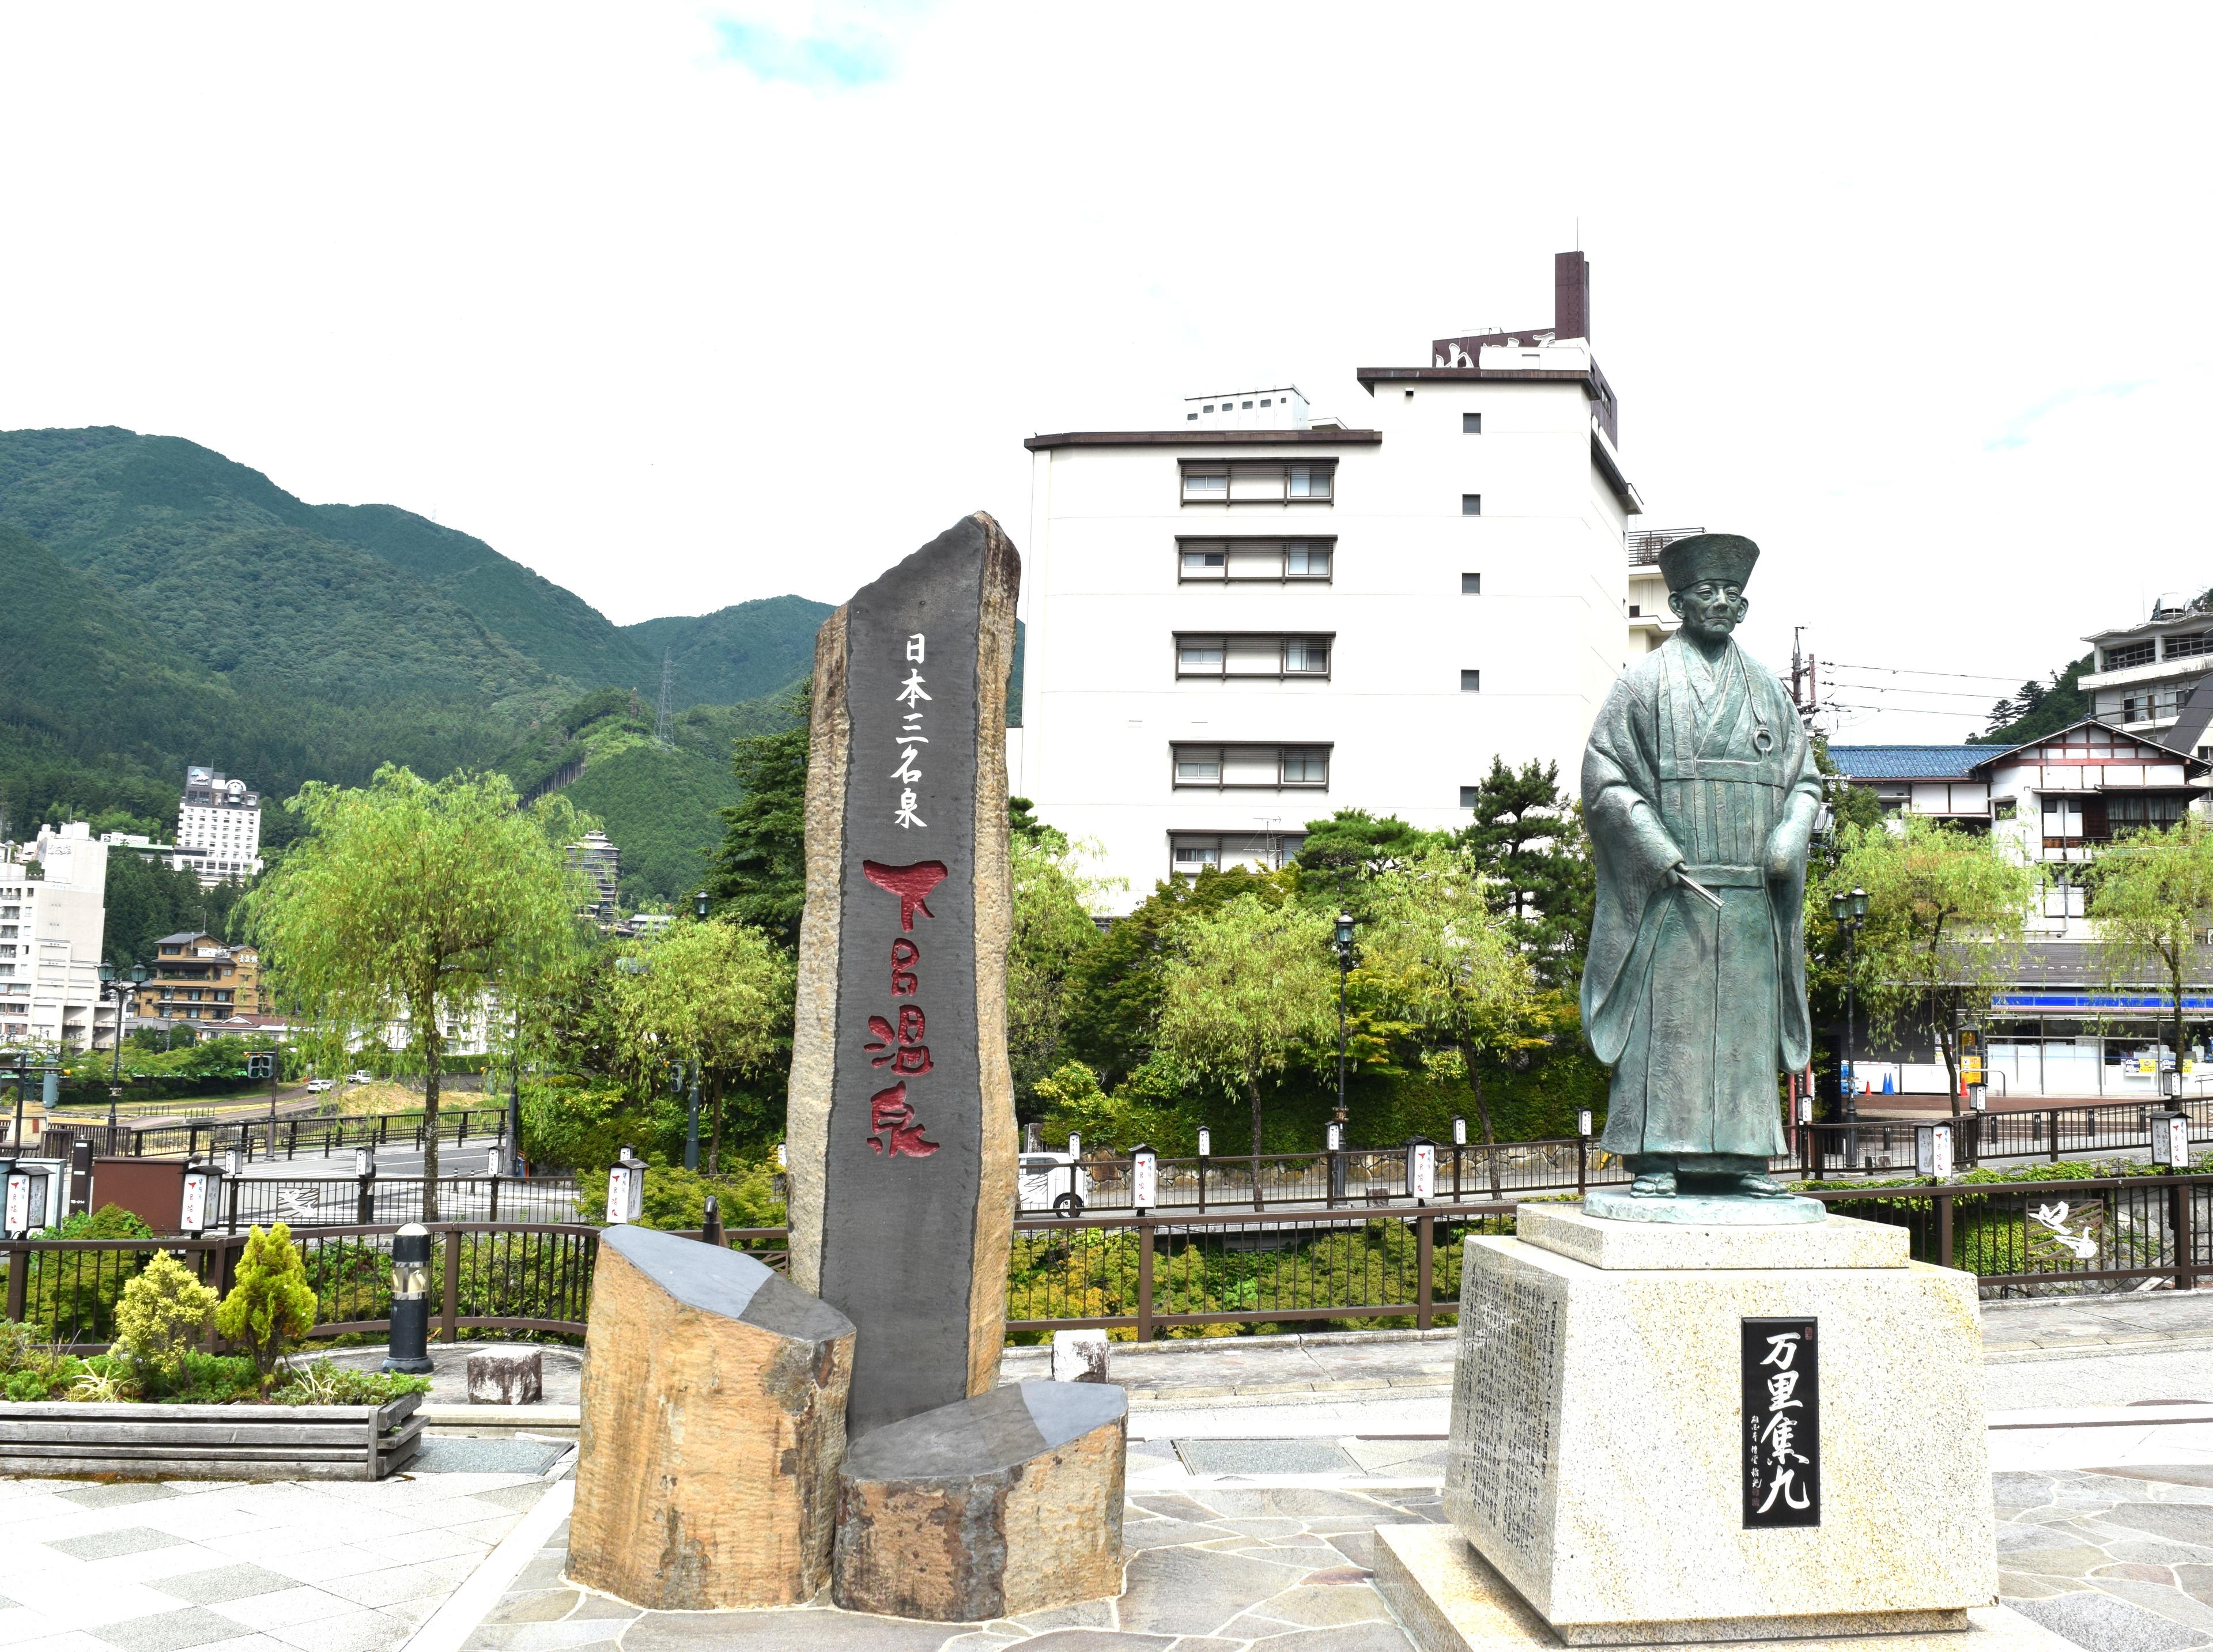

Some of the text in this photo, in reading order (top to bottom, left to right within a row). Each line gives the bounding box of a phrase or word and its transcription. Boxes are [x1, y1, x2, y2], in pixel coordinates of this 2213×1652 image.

[890, 633, 932, 829] 日本三名泉
[862, 859, 948, 1158] 下呂温泉
[1541, 1298, 1558, 1481] 万里集九と下呂温泉
[1757, 1332, 1810, 1513] 万里集九
